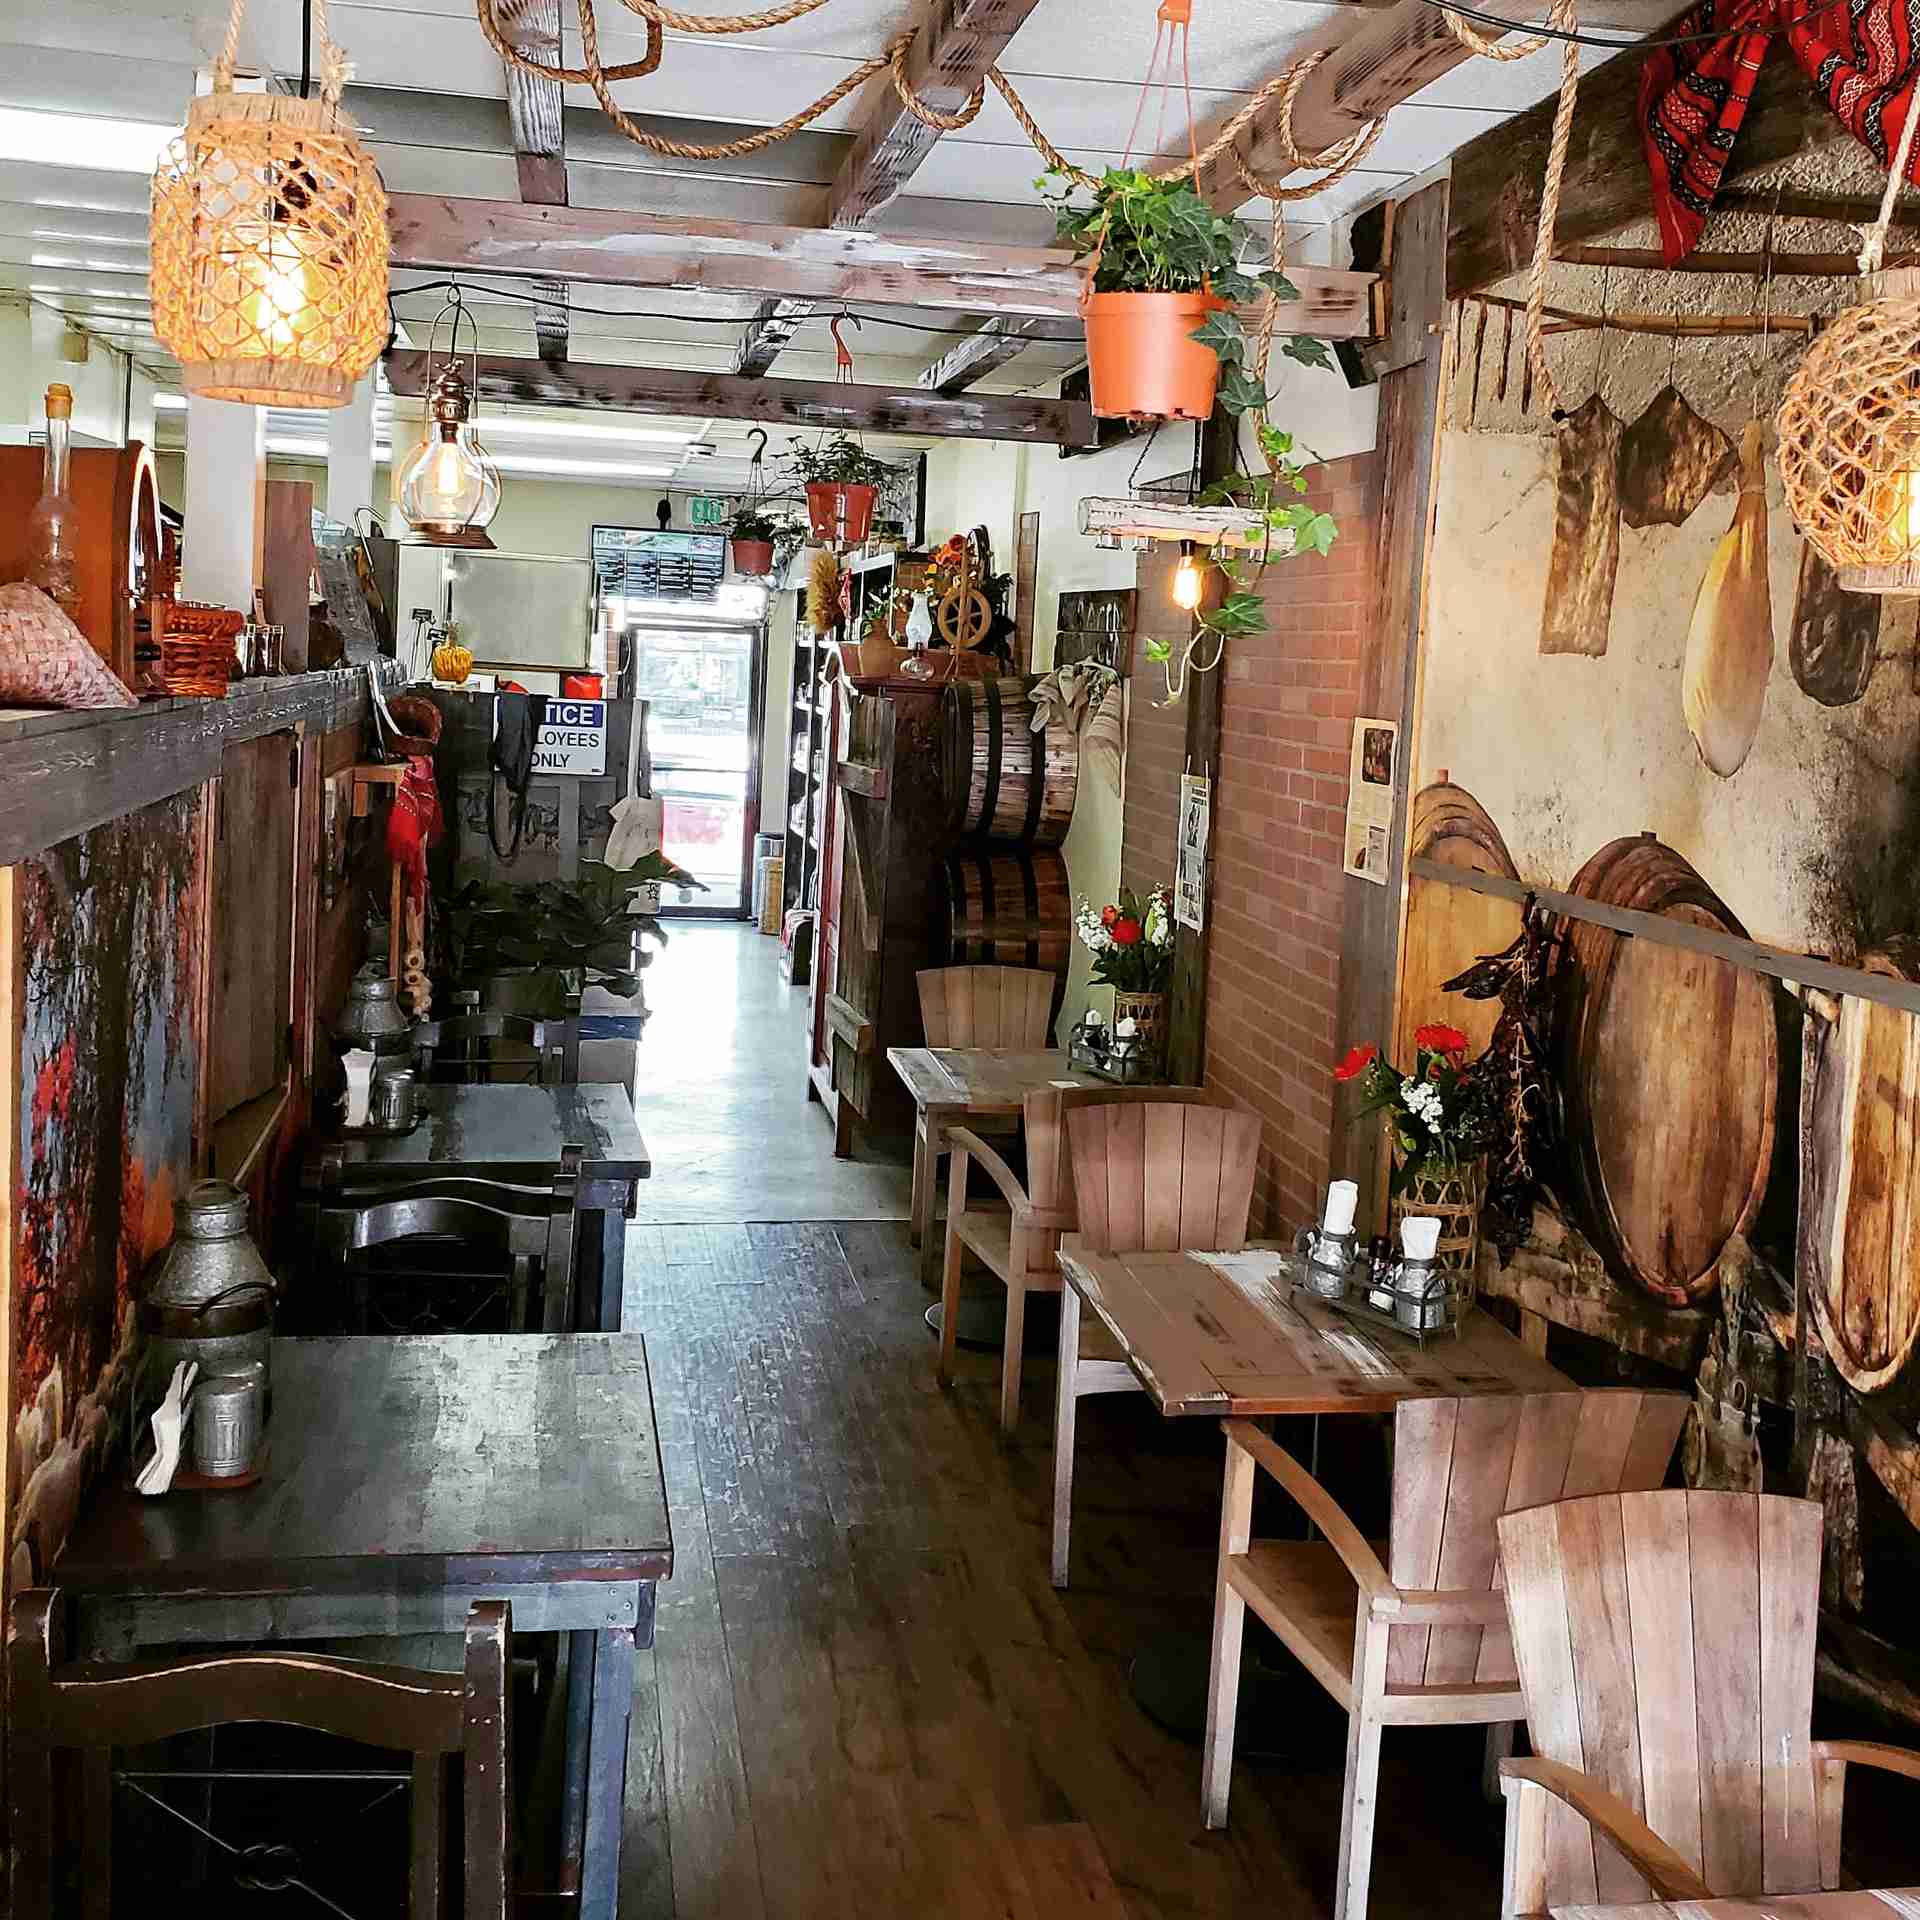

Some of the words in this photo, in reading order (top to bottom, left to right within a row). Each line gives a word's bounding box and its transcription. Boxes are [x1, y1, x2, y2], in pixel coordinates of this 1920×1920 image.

[545, 704, 594, 725] TICE
[537, 730, 600, 748] OYEES
[528, 751, 570, 768] ONLY
